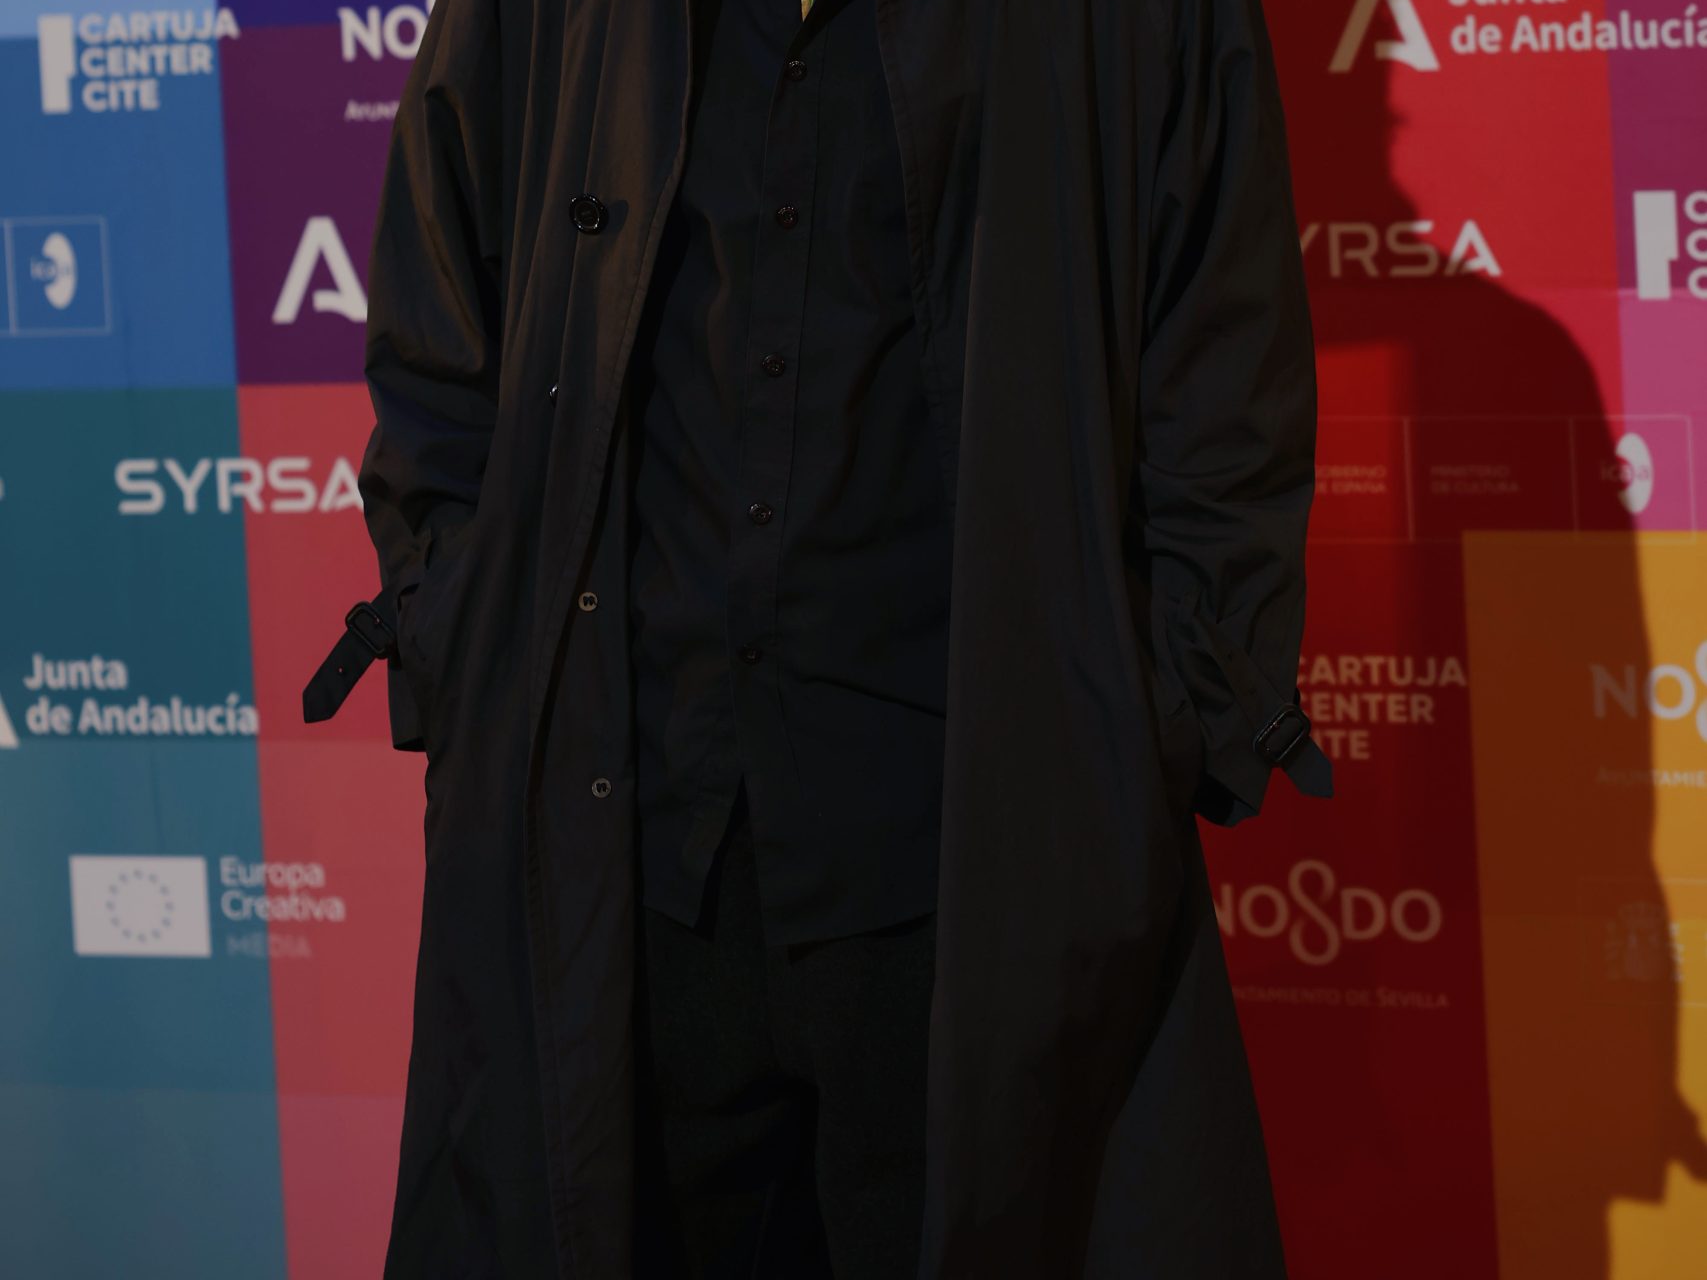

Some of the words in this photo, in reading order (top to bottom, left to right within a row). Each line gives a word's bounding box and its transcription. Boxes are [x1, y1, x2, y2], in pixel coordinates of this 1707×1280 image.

[79, 7, 241, 45] CARTUJA
[1450, 14, 1503, 54] de
[80, 42, 213, 77] CENTER
[82, 78, 160, 112] CITE
[1299, 219, 1502, 278] RSA
[114, 457, 366, 515] SYRSA
[24, 653, 128, 690] Junta
[1299, 691, 1435, 724] ENTER
[1591, 650, 1707, 732] NO
[26, 697, 74, 735] de
[78, 693, 260, 735] Andalucía
[1312, 728, 1371, 760] ITE
[219, 854, 326, 891] Europa
[220, 889, 347, 922] Creativa
